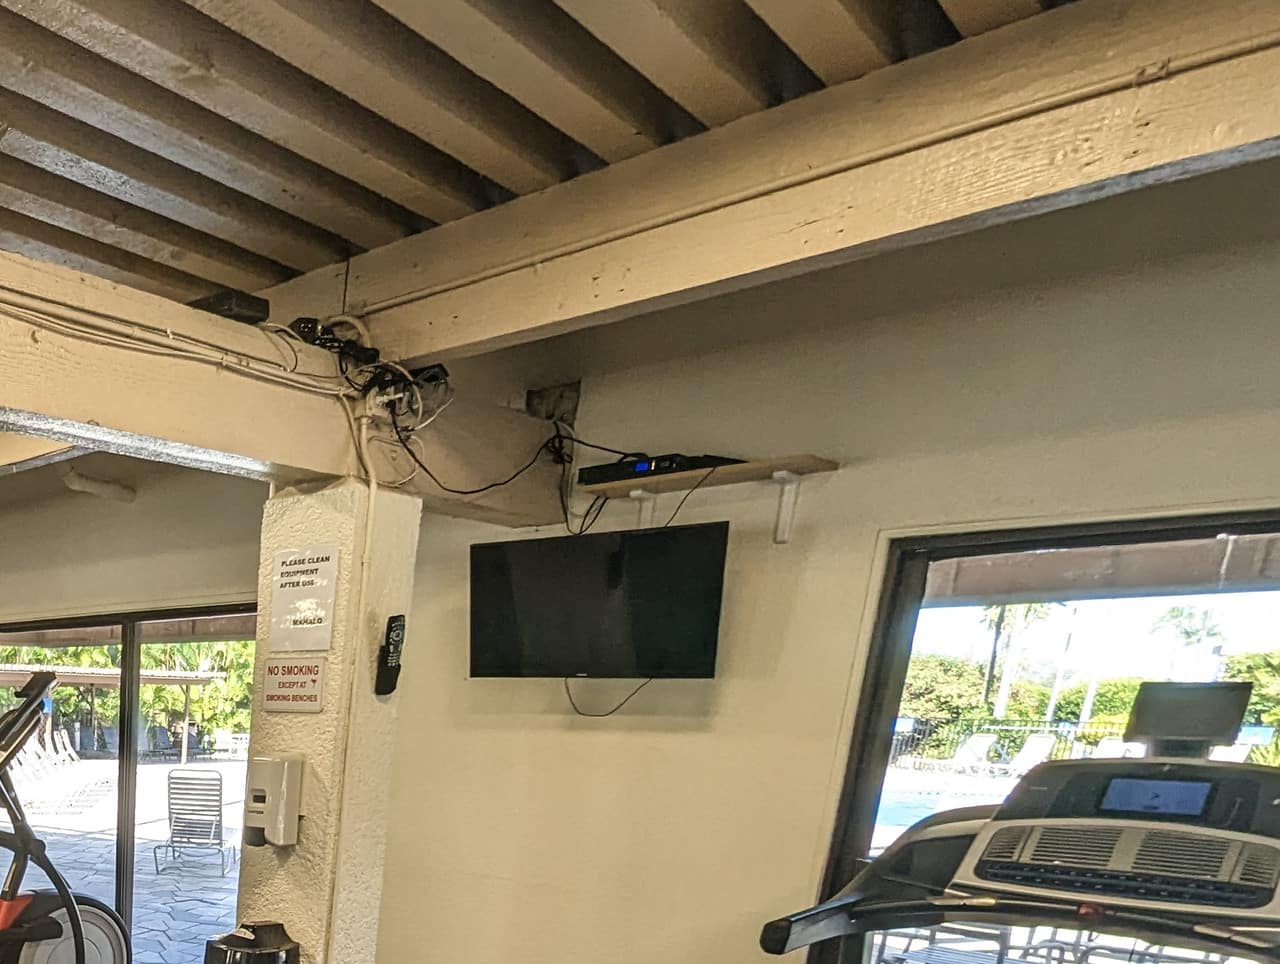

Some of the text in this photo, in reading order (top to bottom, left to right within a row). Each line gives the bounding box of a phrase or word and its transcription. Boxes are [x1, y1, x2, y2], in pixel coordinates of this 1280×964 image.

[281, 556, 330, 567] PLEASE CLEAN
[267, 665, 319, 676] NO SMOKING
[278, 681, 299, 689] EXCEPT
